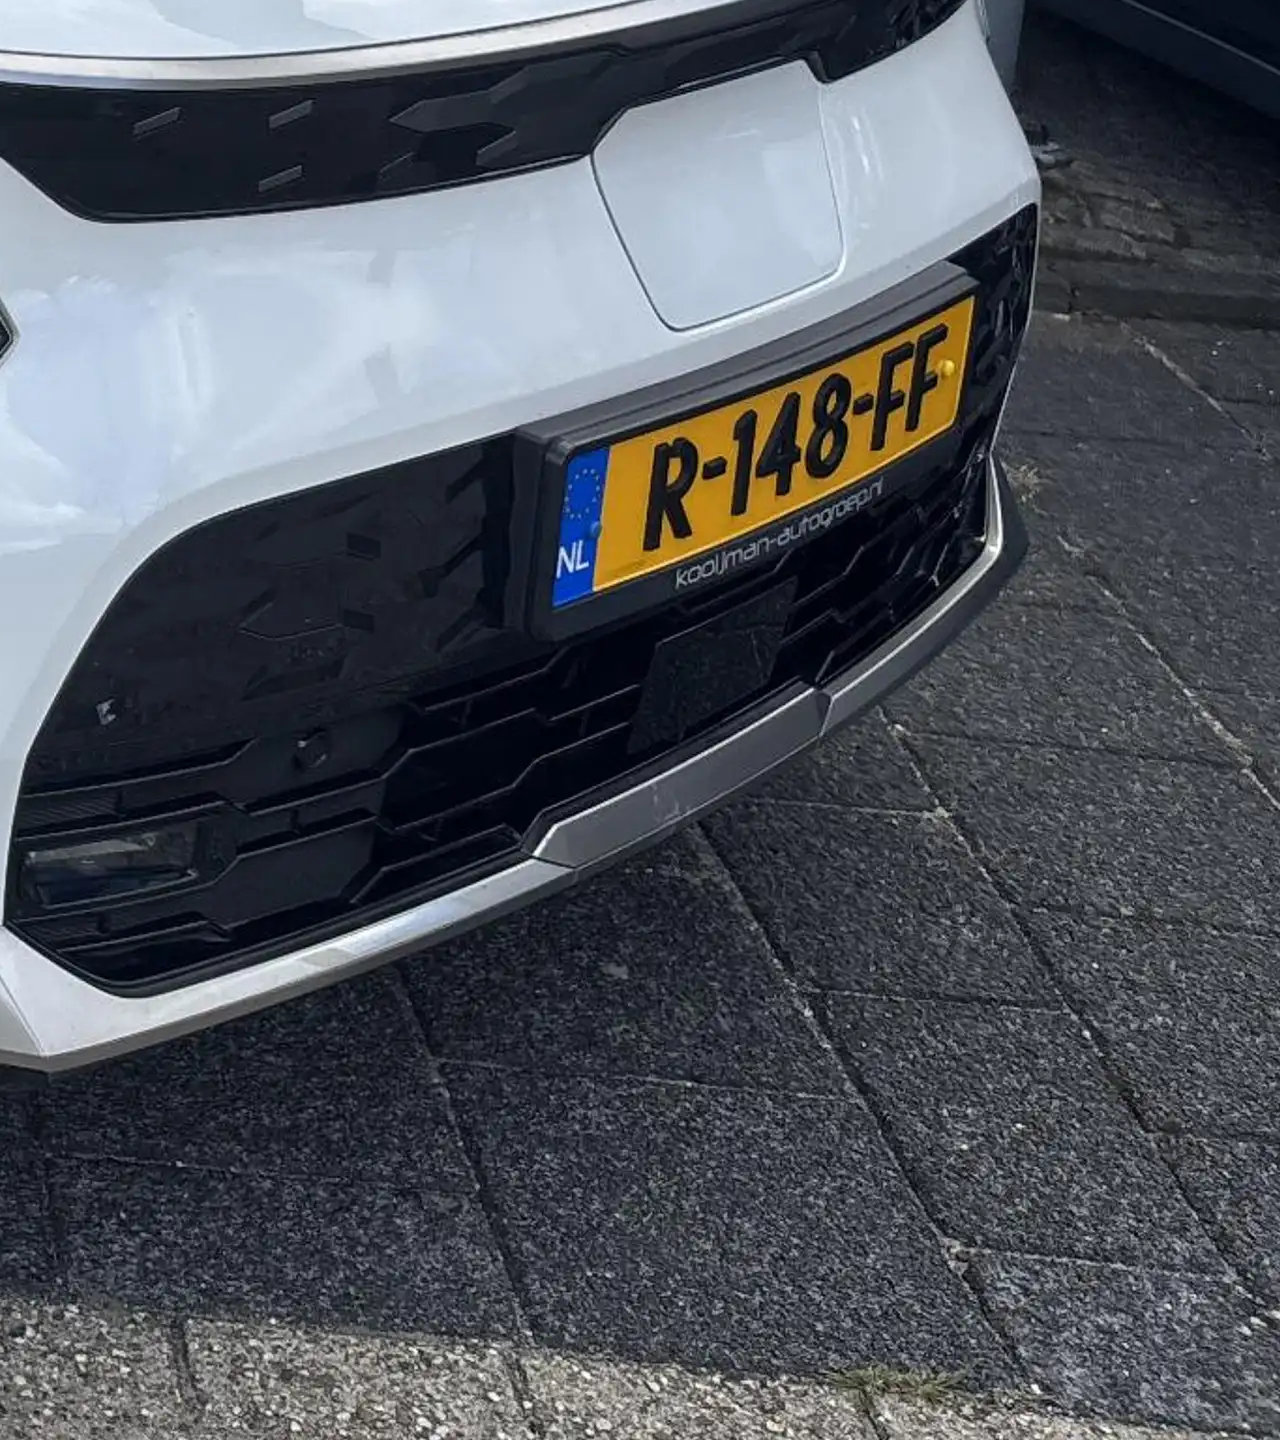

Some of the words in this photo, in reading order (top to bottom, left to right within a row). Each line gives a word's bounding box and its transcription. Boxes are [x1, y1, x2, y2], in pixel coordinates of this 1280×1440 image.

[643, 322, 949, 551] R-148-FF
[556, 539, 590, 579] NL
[674, 475, 885, 591] kooijman-autogroep.nl
